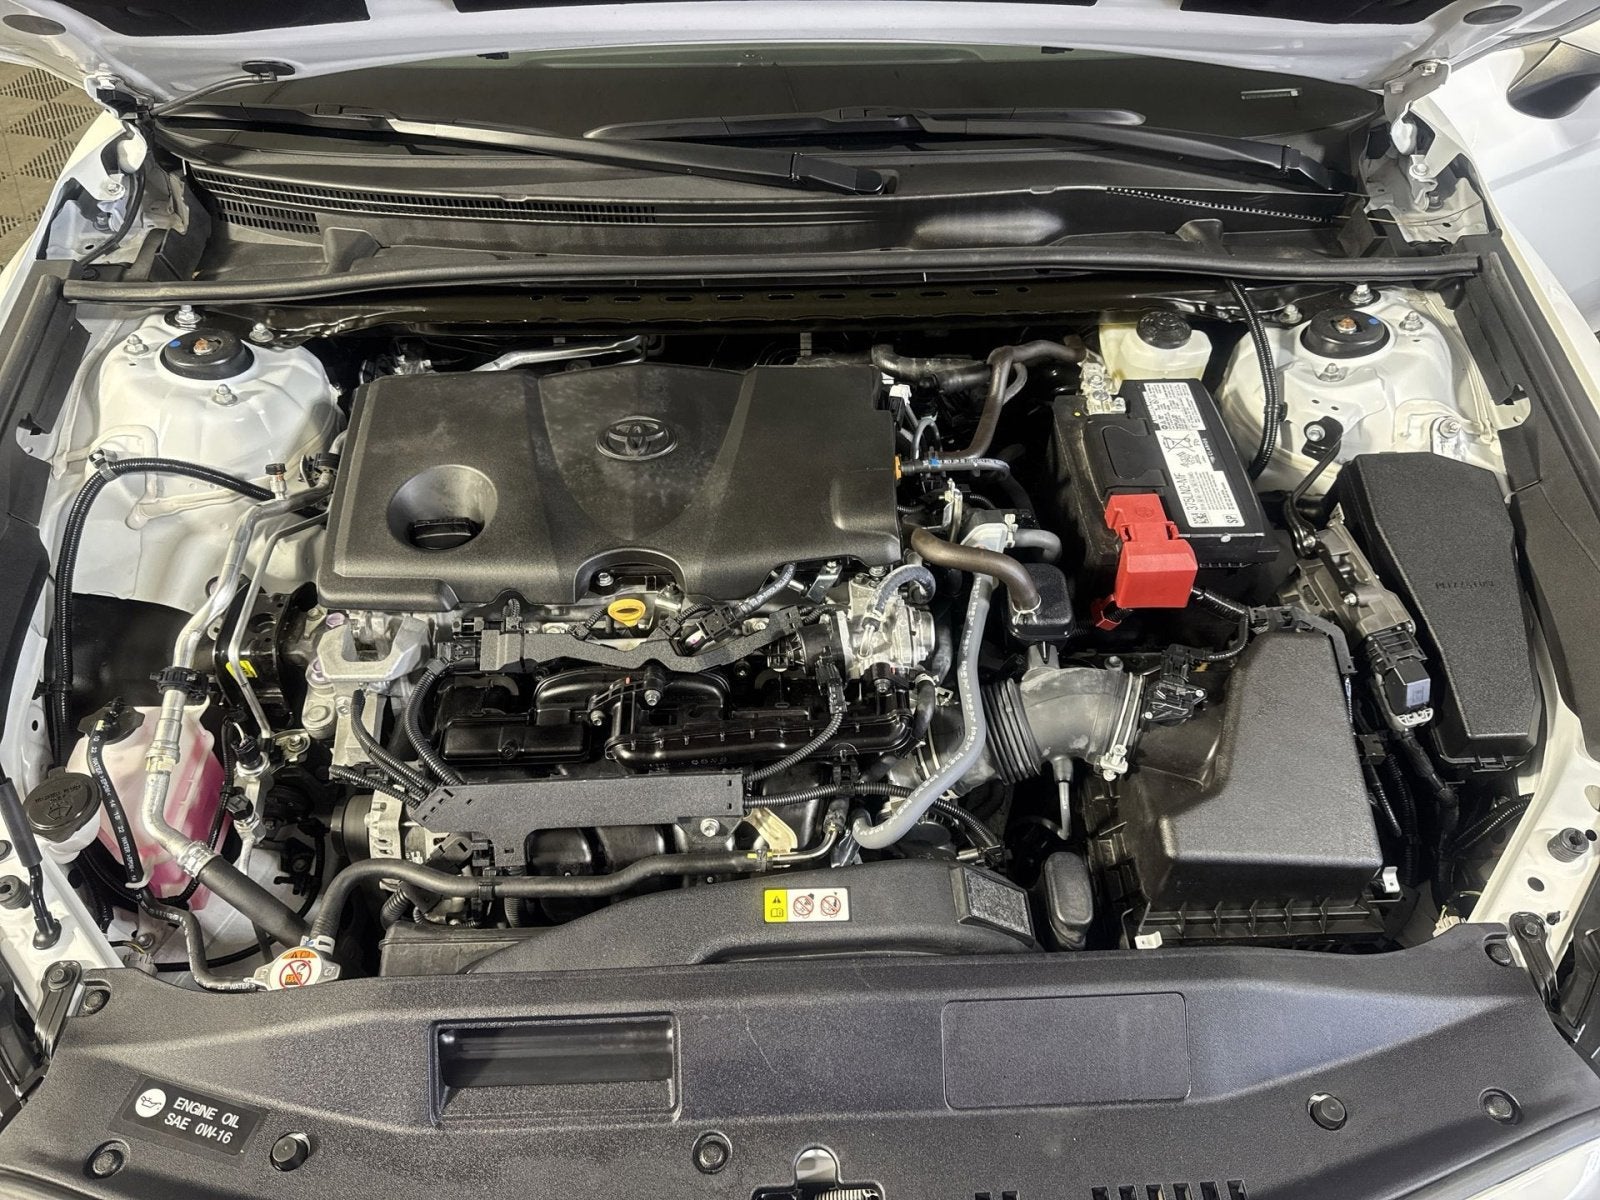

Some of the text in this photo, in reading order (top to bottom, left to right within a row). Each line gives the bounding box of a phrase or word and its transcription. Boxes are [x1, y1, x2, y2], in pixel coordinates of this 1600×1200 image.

[121, 836, 130, 853] WATER
[229, 982, 250, 990] WATER
[173, 1096, 239, 1129] ENGINE OIL
[164, 1112, 233, 1144] SAE 0W-16
